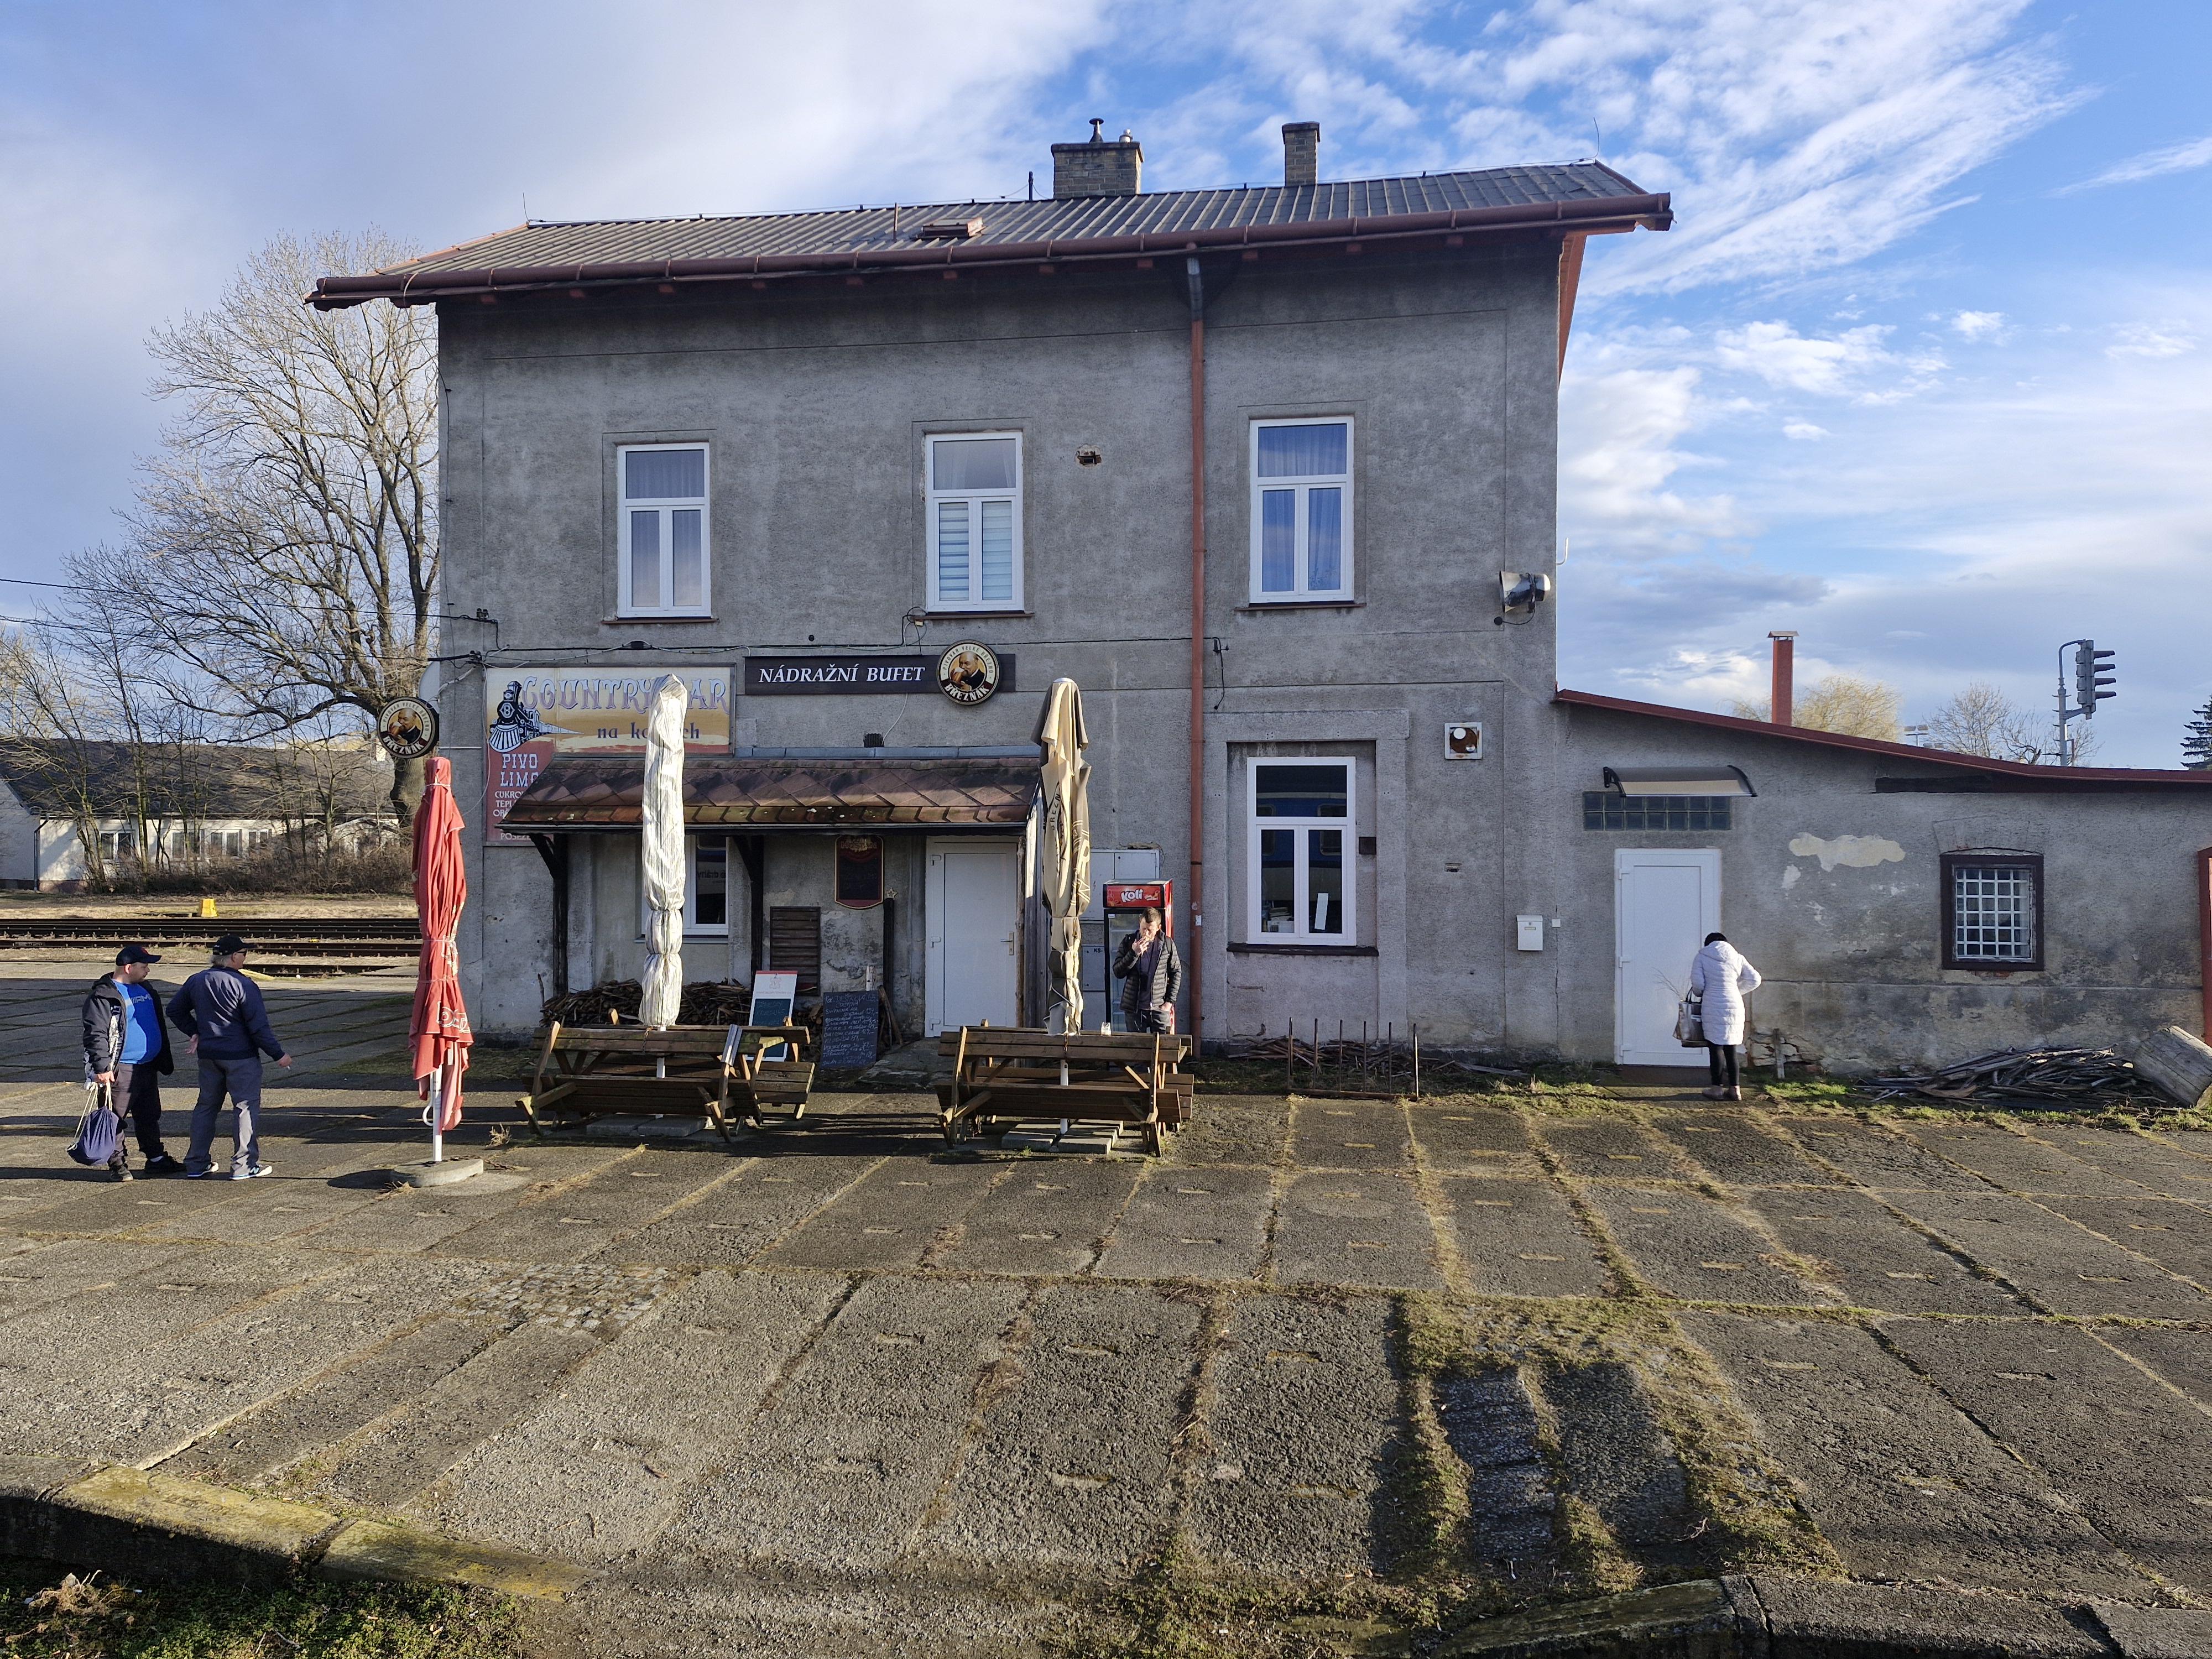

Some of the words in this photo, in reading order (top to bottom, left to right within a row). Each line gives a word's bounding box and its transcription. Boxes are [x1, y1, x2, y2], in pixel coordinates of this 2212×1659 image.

[942, 648, 959, 670] PIVOVAR
[961, 645, 980, 653] VELKÉ
[758, 664, 858, 683] NÁDRAŽNÍ
[866, 666, 925, 682] BUFET
[521, 676, 653, 714] COUNTRY
[944, 683, 990, 701] BŘEZŇÁK
[597, 729, 618, 739] na
[502, 753, 538, 769] PIVO
[494, 790, 524, 800] CUKRO
